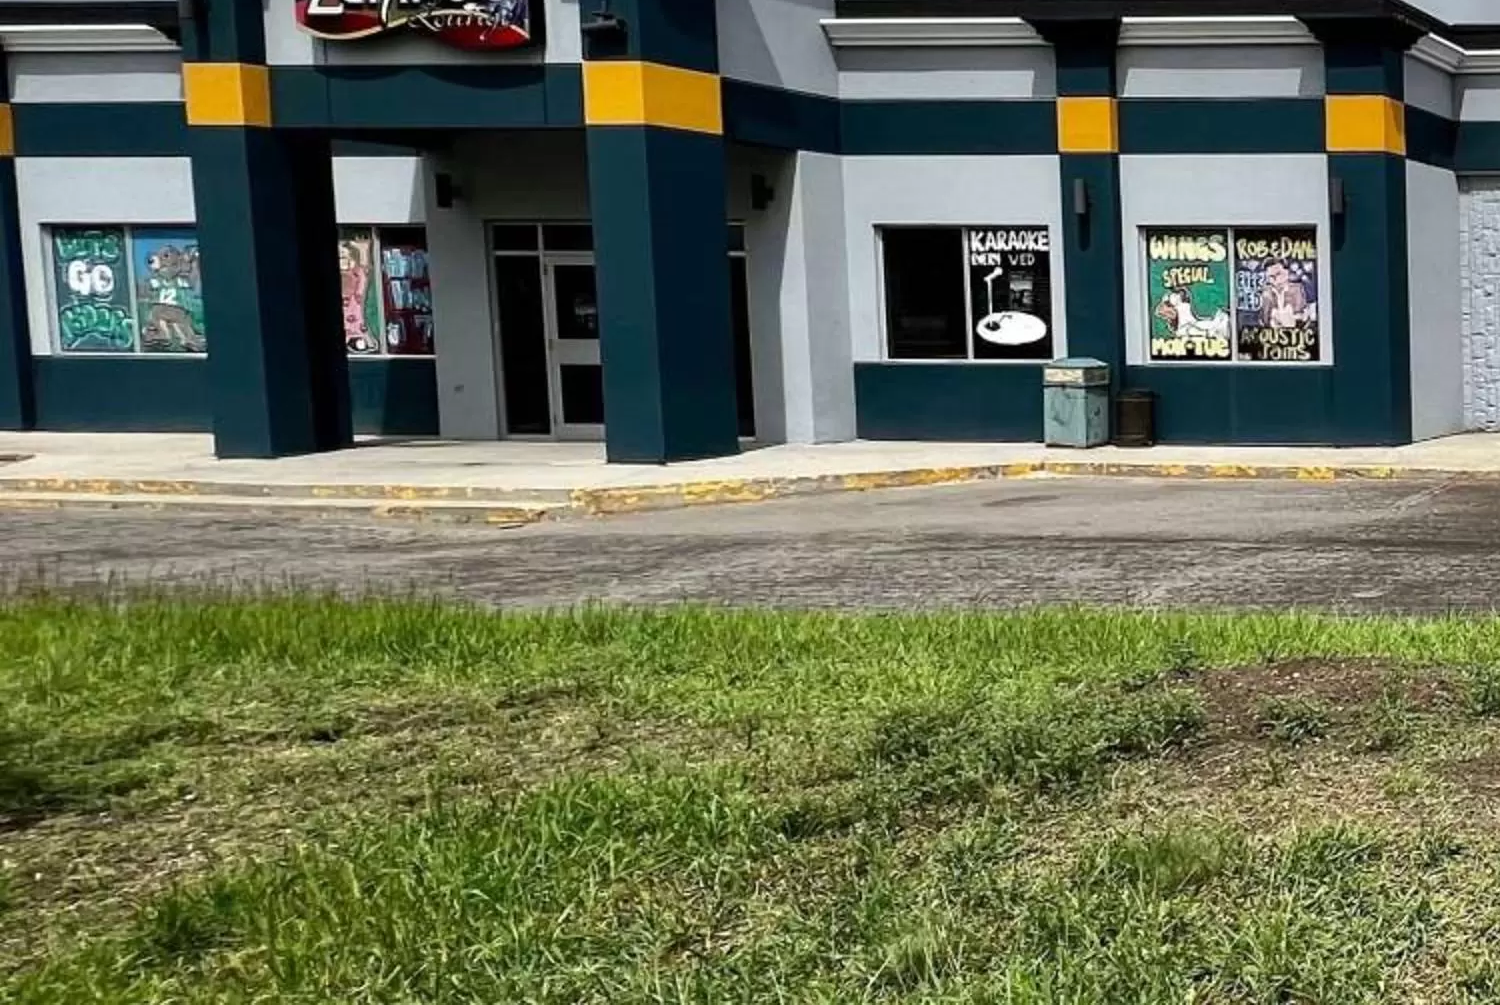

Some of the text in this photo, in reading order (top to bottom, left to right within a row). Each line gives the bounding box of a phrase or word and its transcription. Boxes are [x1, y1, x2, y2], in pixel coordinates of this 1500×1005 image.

[970, 230, 1049, 252] KARAOKE
[1150, 235, 1227, 262] WINGS
[1236, 238, 1268, 260] ROB
[68, 260, 114, 295] GO
